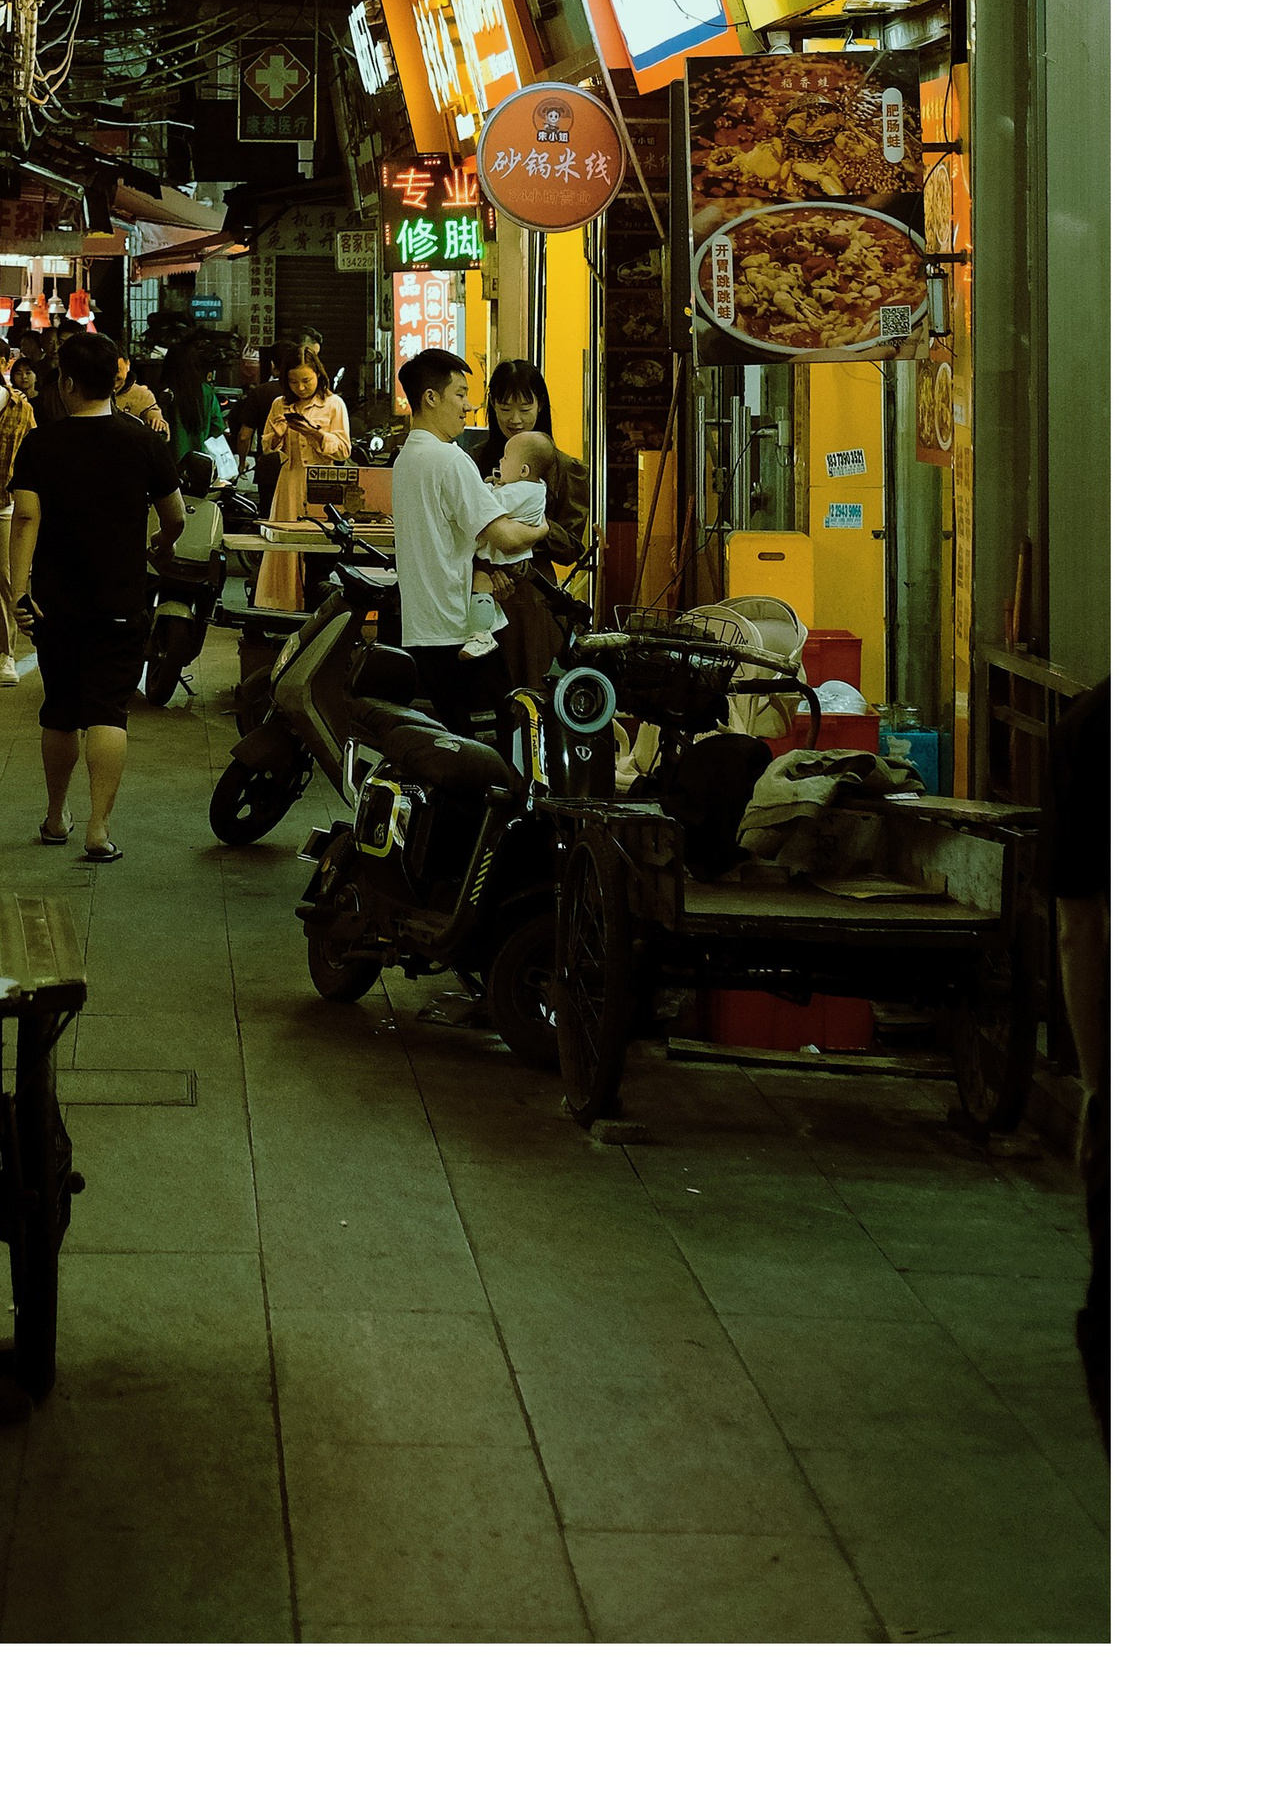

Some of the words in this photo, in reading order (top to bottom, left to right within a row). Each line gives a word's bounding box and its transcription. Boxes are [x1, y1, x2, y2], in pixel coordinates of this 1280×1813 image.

[781, 76, 830, 89] 稻香蛙
[537, 131, 570, 143] 朱小姐
[886, 104, 901, 149] 肥肠蛙
[490, 147, 612, 186] 砂锅米线
[392, 167, 478, 208] 专业
[395, 215, 482, 265] 修脚
[342, 257, 375, 268] 134220
[715, 244, 731, 320] 开胃跳跳蛙
